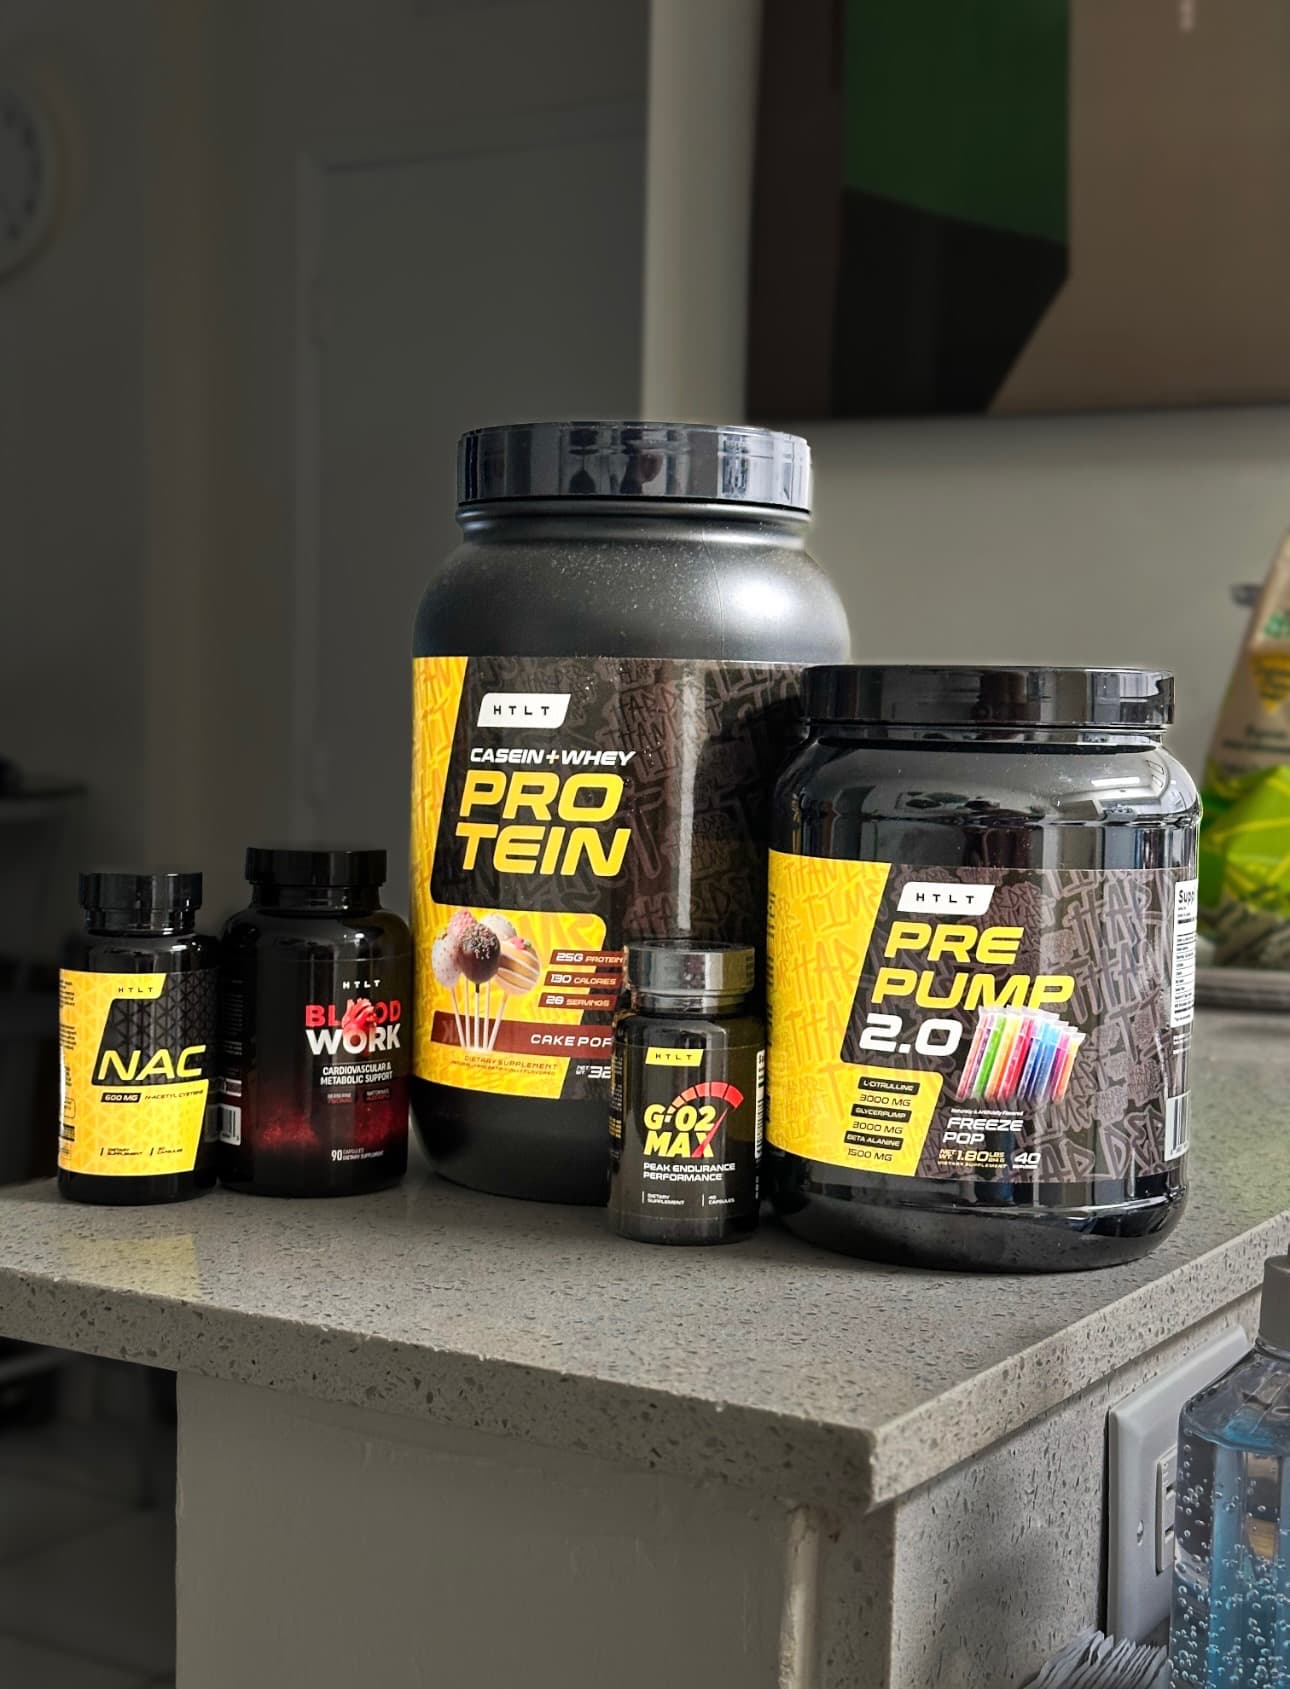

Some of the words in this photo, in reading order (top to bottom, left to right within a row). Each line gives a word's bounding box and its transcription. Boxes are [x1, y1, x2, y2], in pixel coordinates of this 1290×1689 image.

[494, 705, 551, 716] HTLT
[459, 769, 625, 822] PRO
[455, 822, 632, 877] TEIN
[916, 892, 974, 904] HTLT
[884, 921, 1025, 965] PRE
[556, 953, 583, 962] 25G
[343, 980, 381, 989] HTLT
[871, 967, 1075, 1011] PUMP
[305, 999, 401, 1027] BLOD
[305, 1023, 401, 1056] WORK
[531, 1034, 575, 1046] CAKE
[859, 1012, 963, 1056] 2.0
[98, 1045, 207, 1081] NAC
[464, 1055, 496, 1064] DIETARY
[497, 1060, 558, 1070] SUPPLEMENT
[656, 1053, 692, 1061] HTLT
[322, 1063, 386, 1075] CARDIOVASCULAR
[387, 1062, 392, 1070] &
[320, 1075, 364, 1085] METABOLIC
[365, 1071, 393, 1083] SUPPORT
[859, 1094, 889, 1105] 3000
[891, 1098, 912, 1107] MG
[855, 1107, 906, 1118] GLYCERPUMP
[852, 1121, 882, 1132] 3000
[884, 1125, 904, 1134] MG
[947, 1117, 1024, 1131] FREEZE
[643, 1130, 715, 1158] MAX
[847, 1133, 865, 1142] BETA
[866, 1136, 900, 1147] ALANINE
[943, 1132, 985, 1145] POP
[331, 1149, 343, 1161] 90
[848, 1148, 872, 1158] 1500
[874, 1152, 893, 1162] MG
[957, 1150, 989, 1162] 1.80
[1014, 1152, 1041, 1164] 40
[643, 1162, 671, 1172] PEAK
[672, 1162, 736, 1173] ENDURANCE
[643, 1171, 723, 1182] PERFORMANCE
